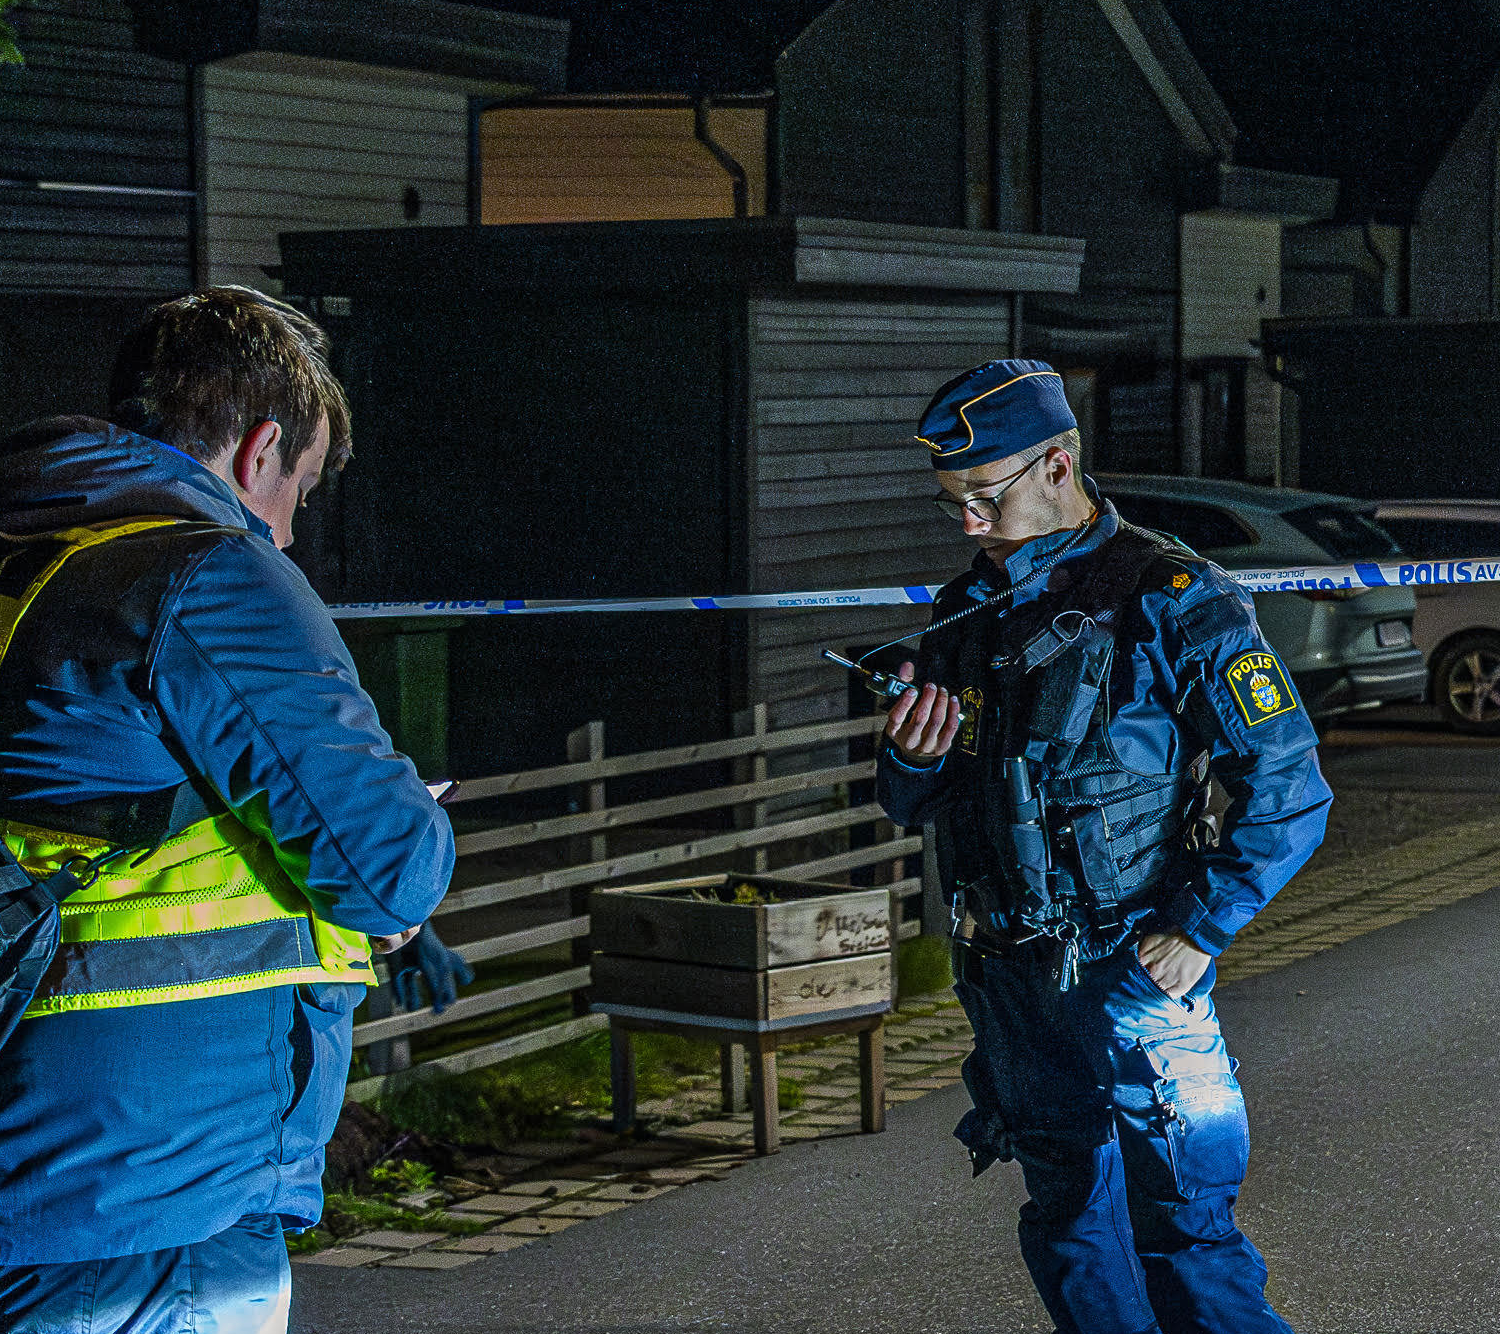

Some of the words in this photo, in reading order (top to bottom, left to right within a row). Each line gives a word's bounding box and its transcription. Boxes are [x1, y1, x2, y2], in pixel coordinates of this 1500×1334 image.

[1260, 572, 1271, 580] DO
[1278, 570, 1305, 579] POLICE
[1399, 562, 1472, 586] POLIS
[1231, 655, 1272, 682] POLIS
